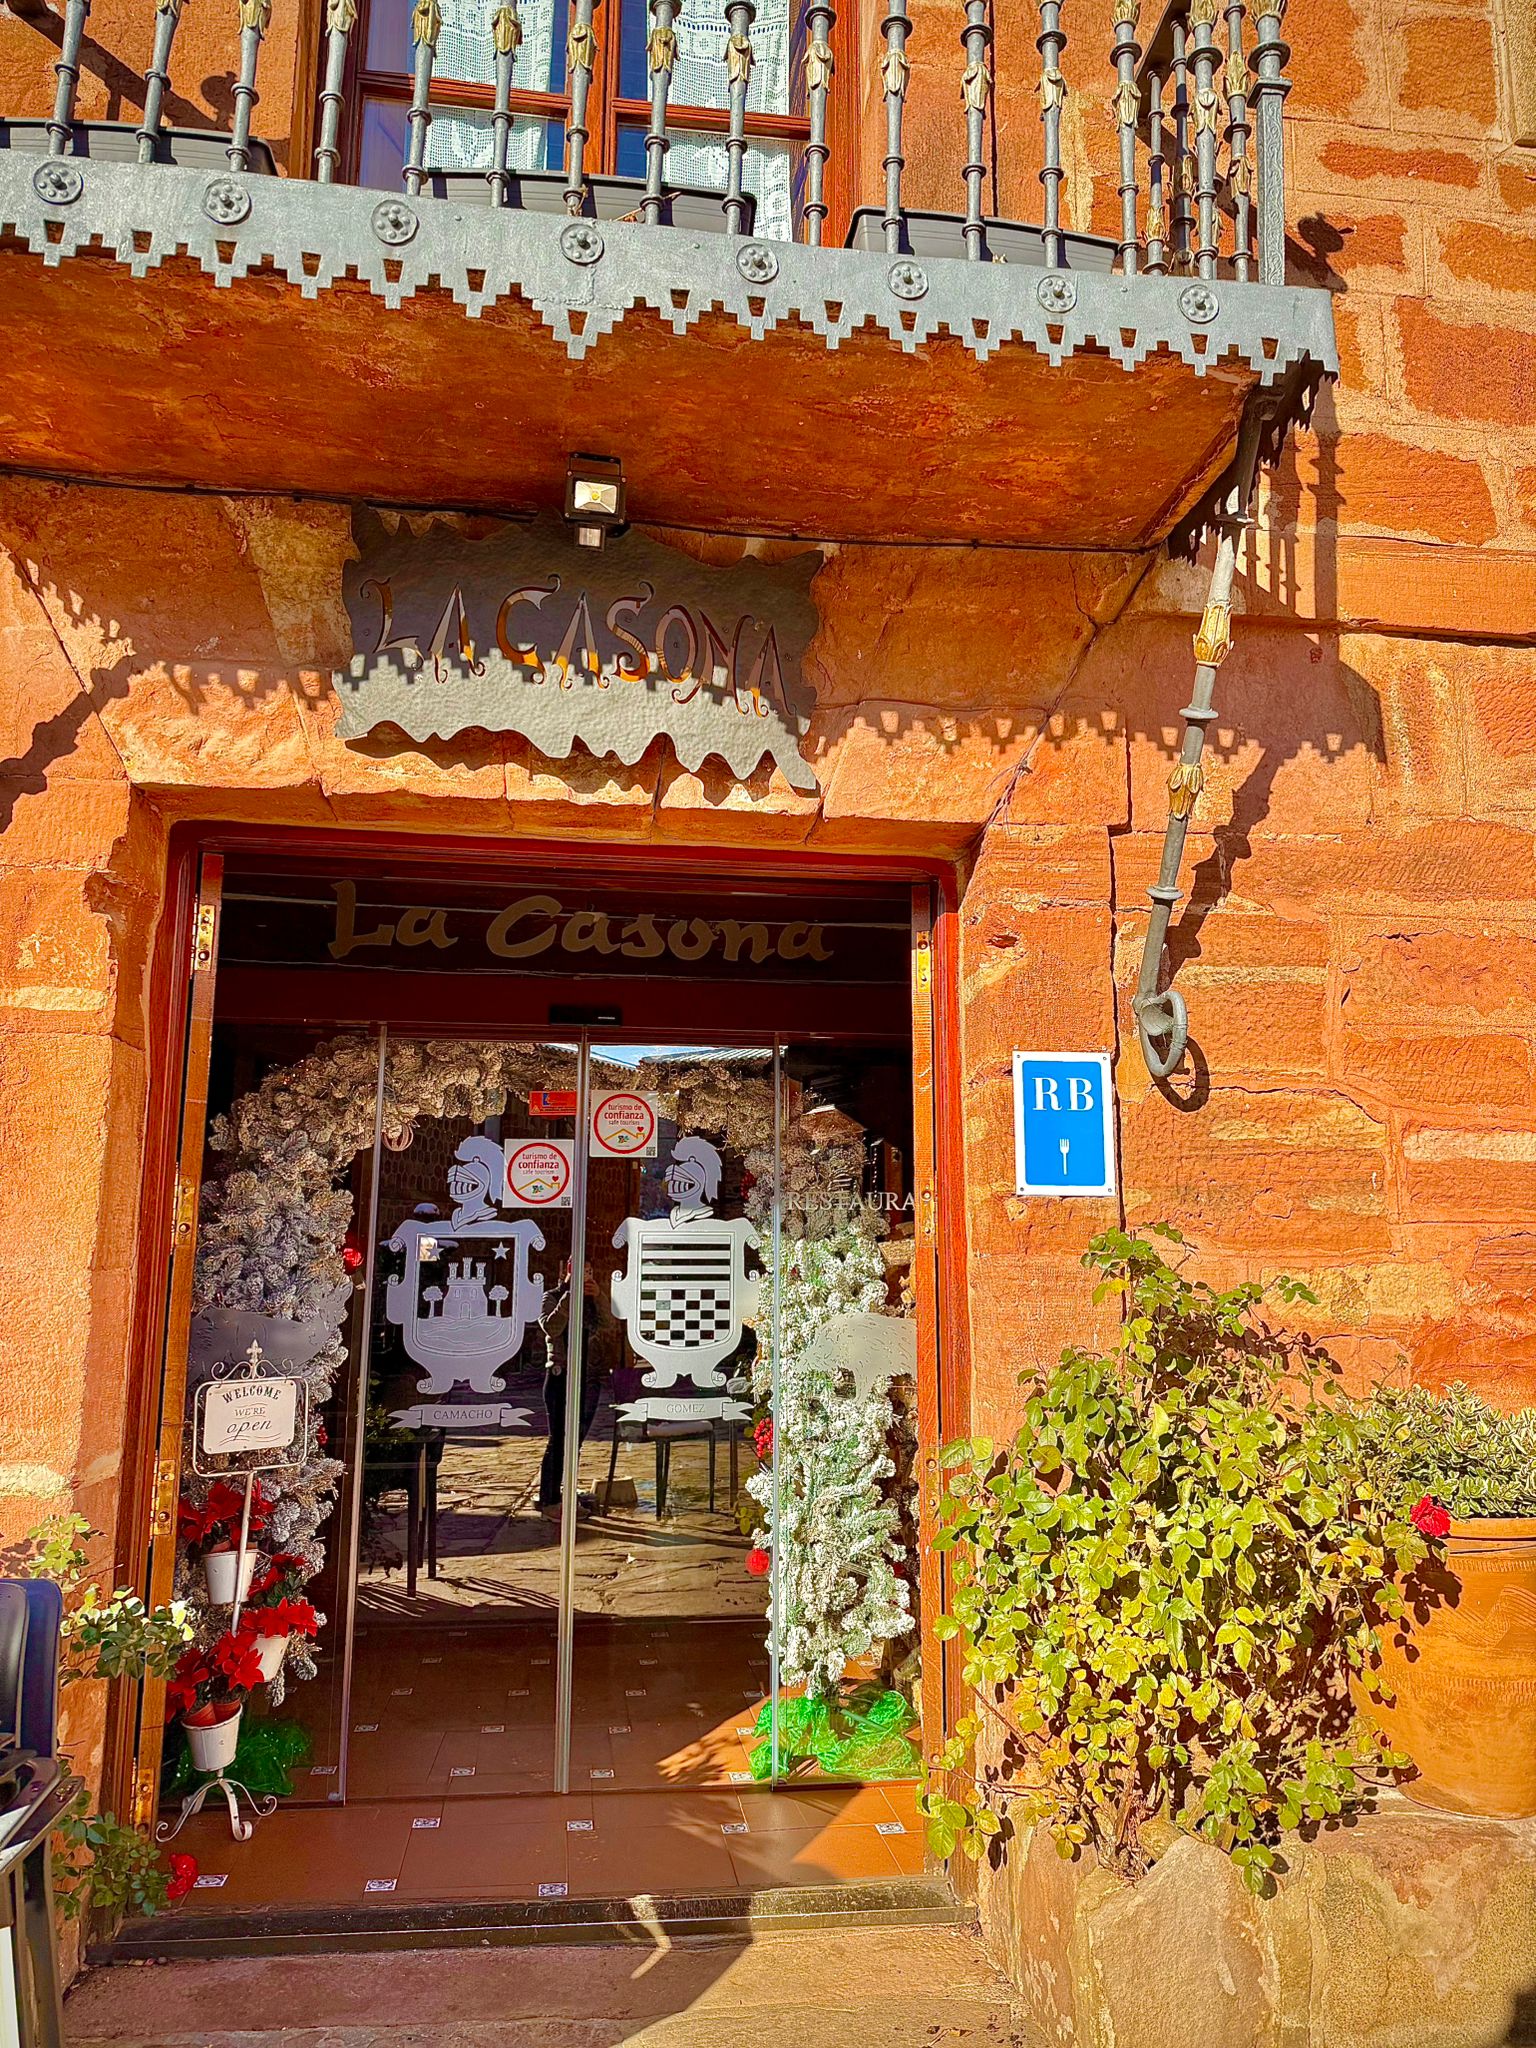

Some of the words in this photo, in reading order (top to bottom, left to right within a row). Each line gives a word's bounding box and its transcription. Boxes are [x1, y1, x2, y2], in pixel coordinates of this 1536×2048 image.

[360, 576, 486, 684] LA
[496, 574, 798, 718] CASONA
[327, 879, 459, 960] La
[486, 895, 835, 963] Casona
[1031, 1077, 1096, 1112] RB
[608, 1103, 632, 1111] turismo
[634, 1103, 642, 1111] de
[604, 1110, 645, 1120] confianza
[522, 1152, 547, 1160] turismo
[549, 1152, 558, 1160] de
[518, 1159, 560, 1169] confianza
[222, 1384, 282, 1404] WELCOME
[666, 1403, 705, 1414] GOMEZ
[433, 1409, 493, 1420] CAMACHO
[226, 1419, 273, 1441] open
